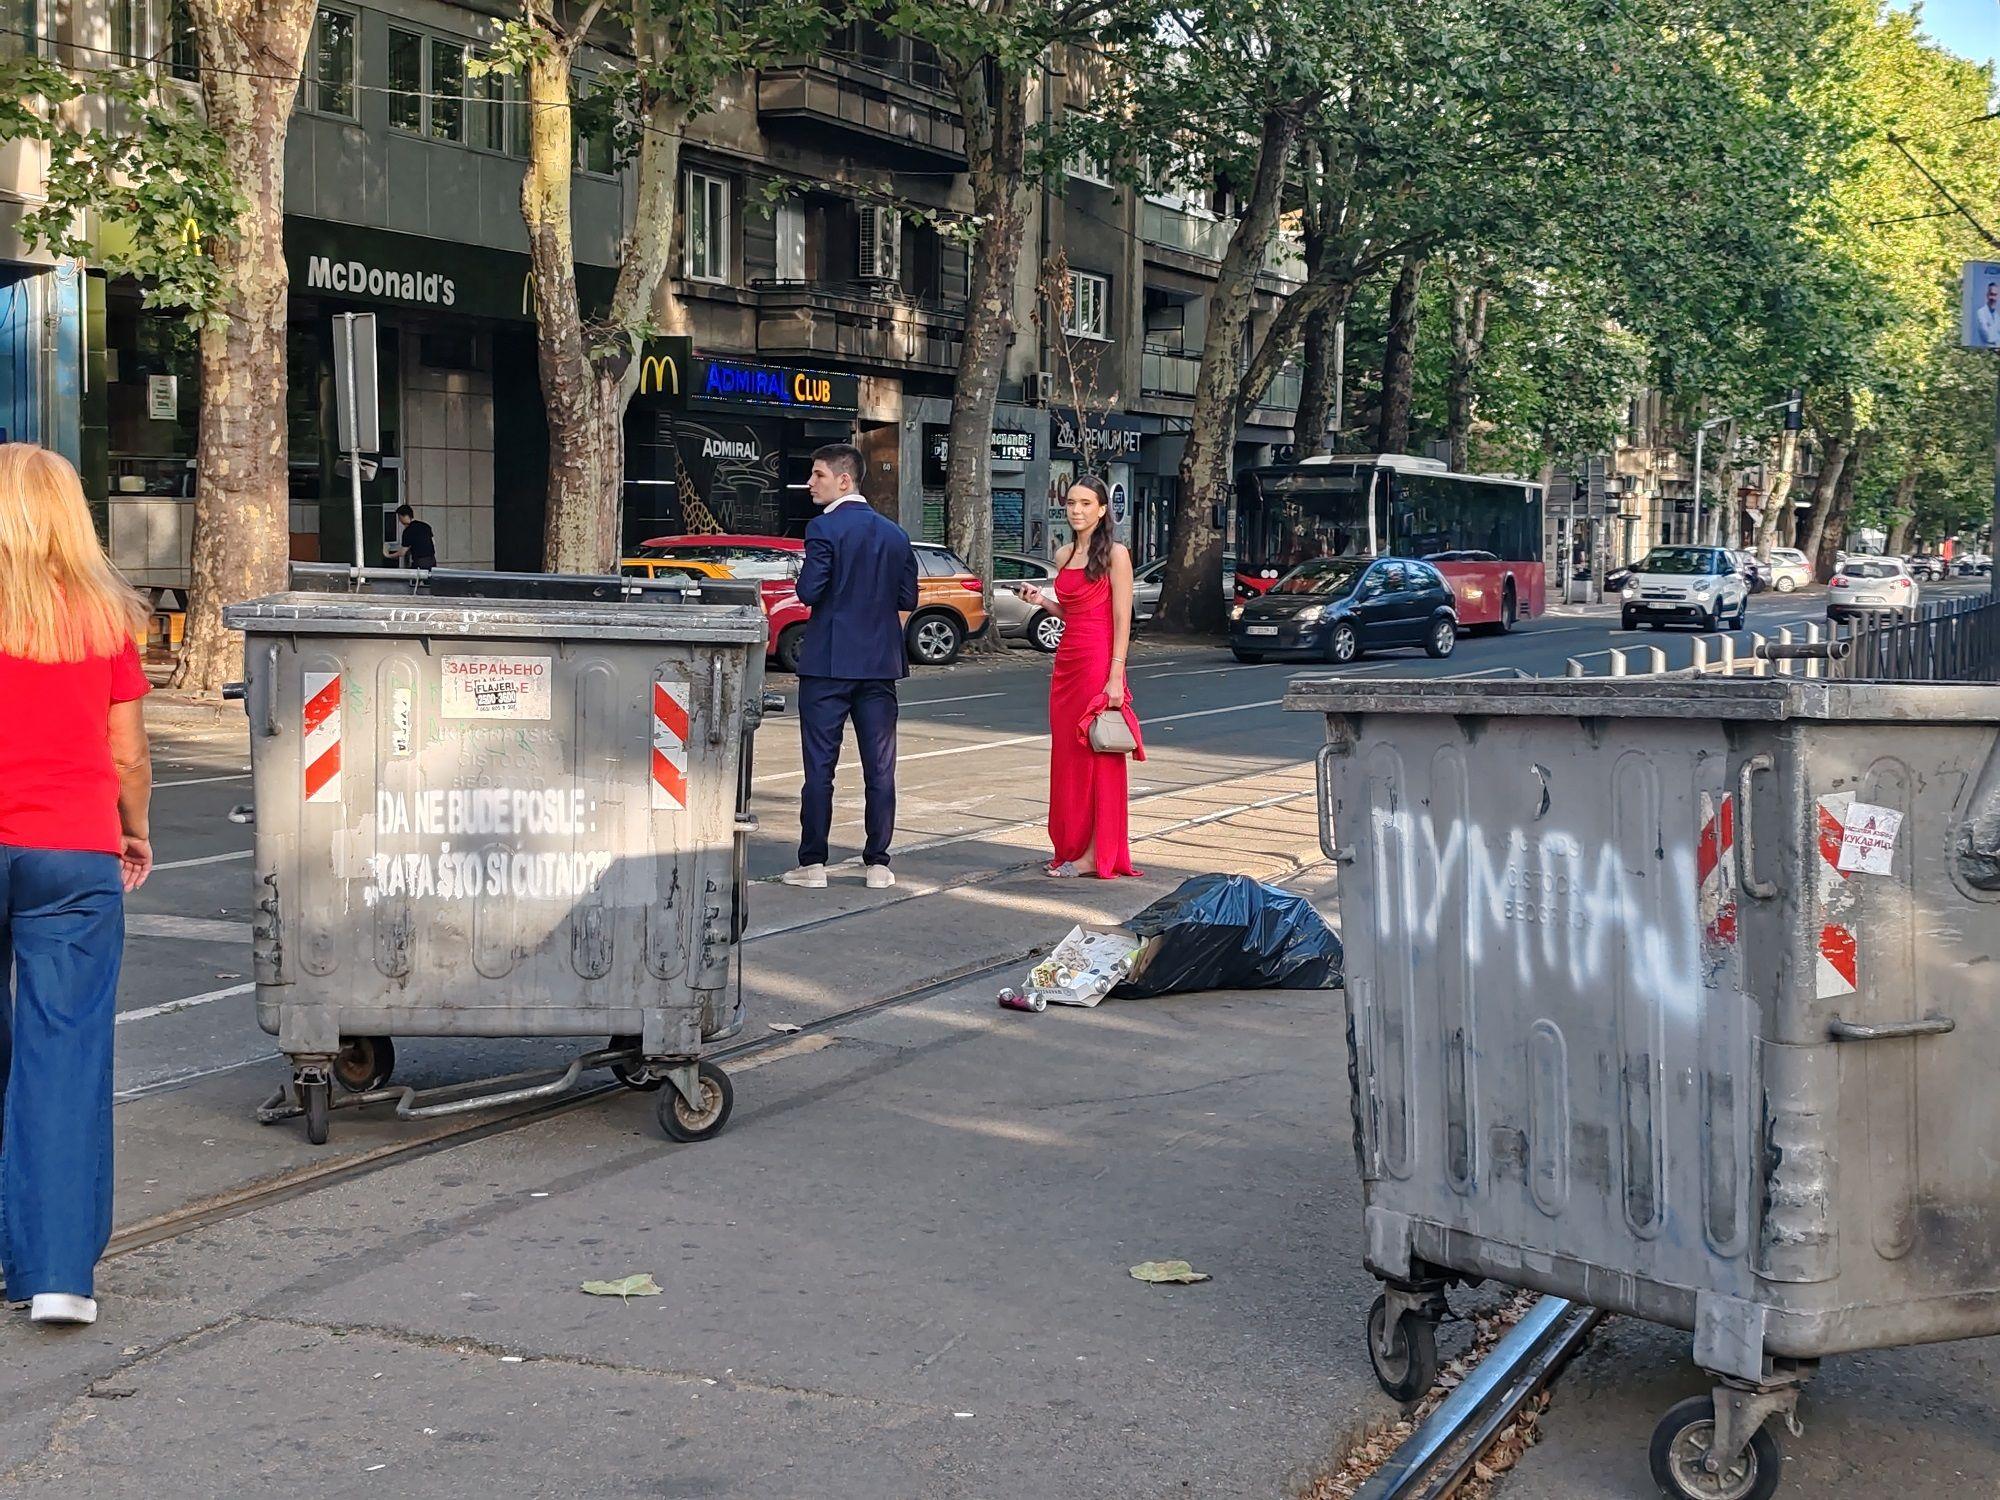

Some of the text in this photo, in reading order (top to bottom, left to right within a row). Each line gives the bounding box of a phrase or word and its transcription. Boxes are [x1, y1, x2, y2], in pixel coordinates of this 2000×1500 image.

[307, 255, 456, 306] McDonald's
[706, 363, 831, 403] ADMIRAL CLUB
[701, 437, 760, 461] ADMIRAL
[1124, 431, 1142, 452] PET
[450, 662, 544, 676] ЗАБРАЊЕНО
[477, 682, 515, 693] FLAJERI
[377, 790, 411, 834] DA
[414, 790, 446, 834] NE
[448, 789, 511, 834] BUDE
[512, 788, 586, 834] POSLE
[437, 841, 484, 901] ŠTO
[486, 852, 509, 897] SI
